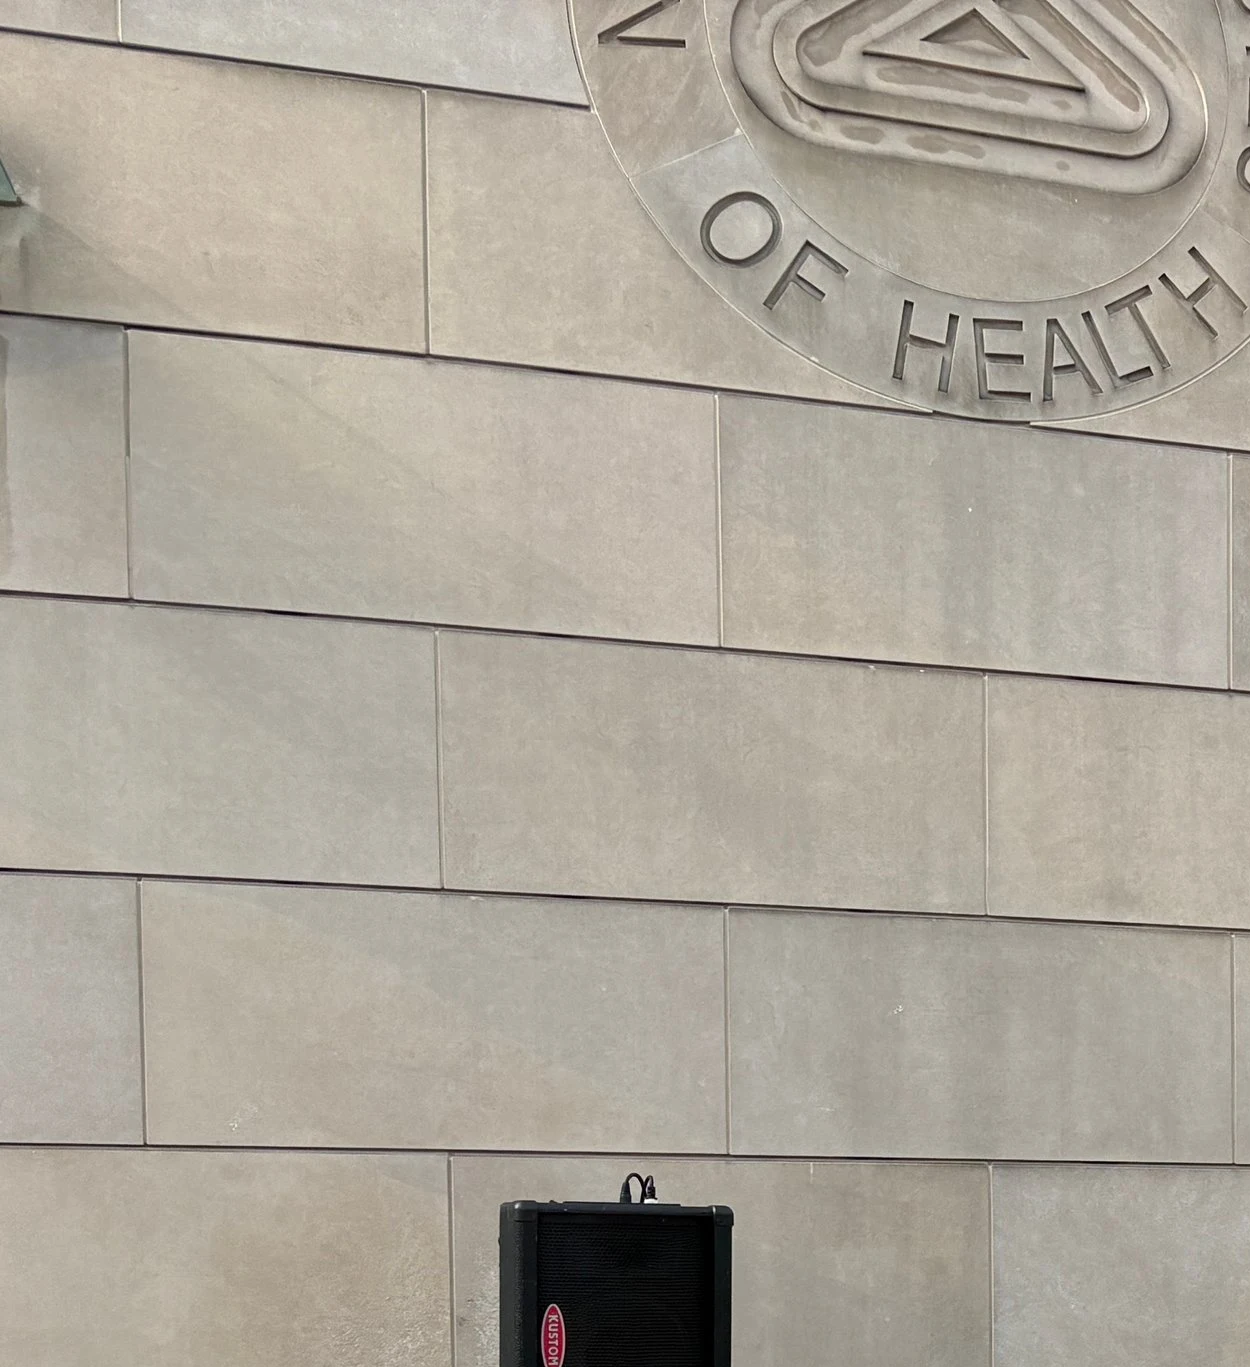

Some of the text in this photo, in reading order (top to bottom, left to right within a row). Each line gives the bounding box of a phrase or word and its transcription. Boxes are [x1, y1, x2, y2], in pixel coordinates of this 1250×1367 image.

[700, 190, 1249, 403] OF HEALTH
[548, 1314, 559, 1366] KUSTOM
